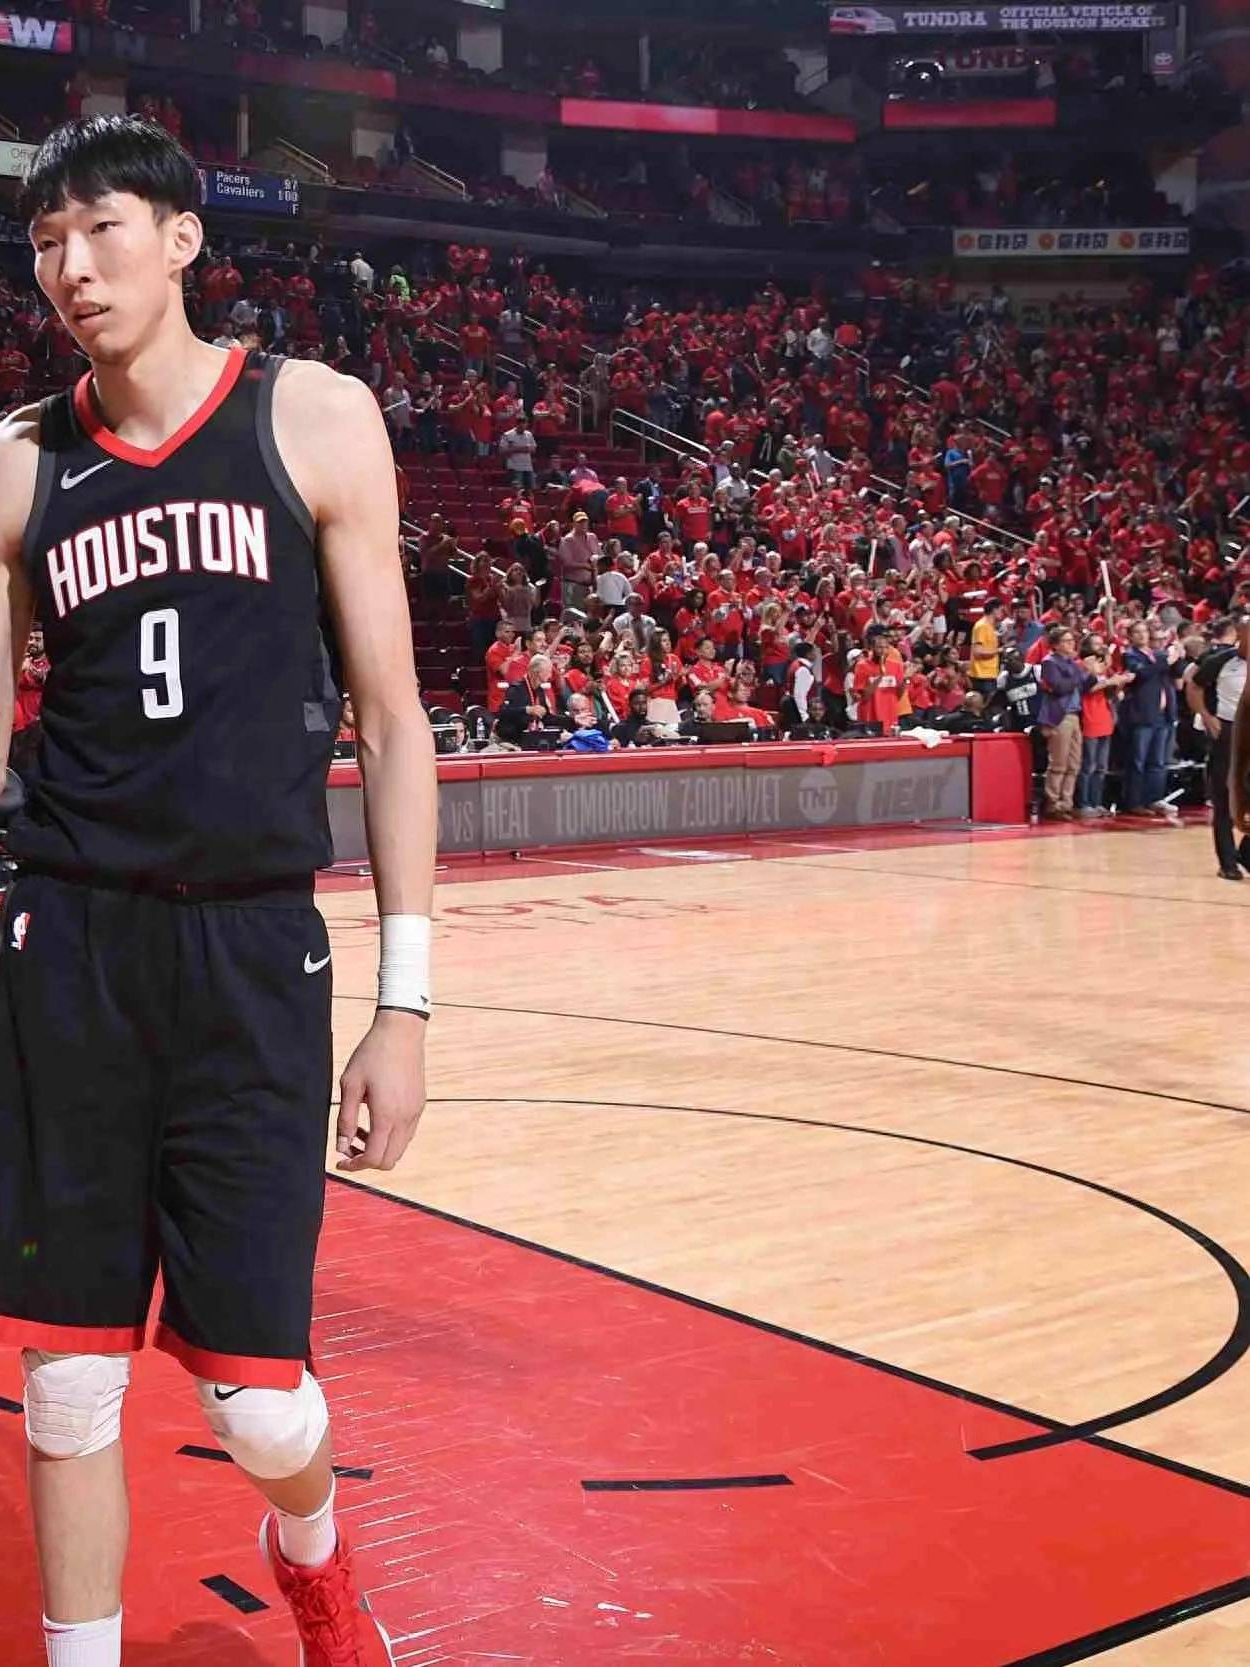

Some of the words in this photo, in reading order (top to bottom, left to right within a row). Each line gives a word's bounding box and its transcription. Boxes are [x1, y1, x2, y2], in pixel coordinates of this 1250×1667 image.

[903, 11, 988, 27] TUNDRA
[1000, 7, 1070, 18] OFFICIAL
[1072, 5, 1134, 17] VEHICLE
[1001, 19, 1030, 29] THE
[1032, 18, 1097, 29] HOUSTON
[1101, 17, 1167, 28] ROCKETS
[216, 170, 251, 186] Pacers
[216, 183, 266, 199] Cavaliers
[277, 190, 299, 202] 100
[45, 498, 272, 619] HOUSTON
[140, 607, 184, 720] 9
[482, 784, 533, 842] HEAT
[552, 778, 670, 839] TOMORROW
